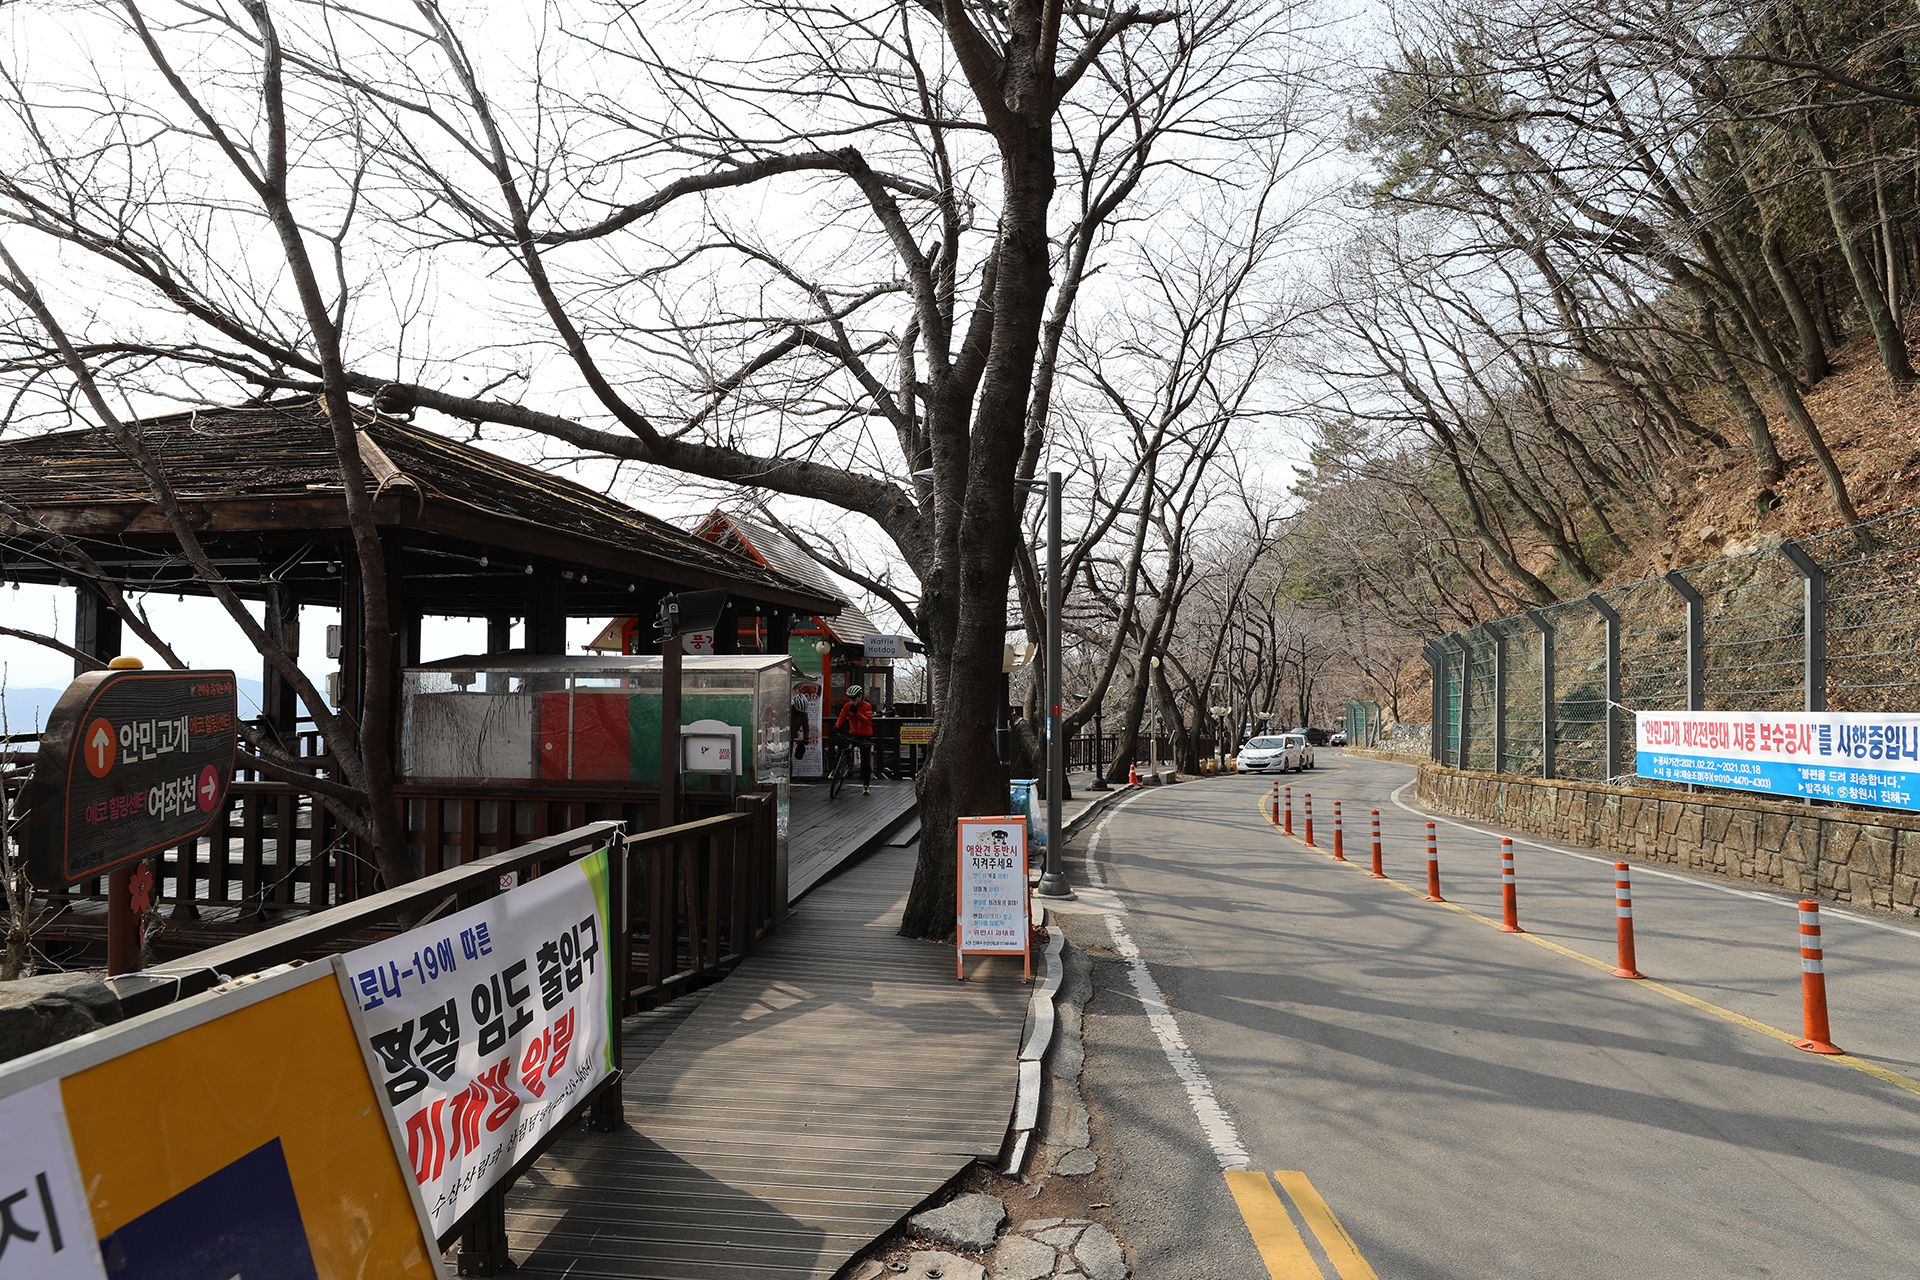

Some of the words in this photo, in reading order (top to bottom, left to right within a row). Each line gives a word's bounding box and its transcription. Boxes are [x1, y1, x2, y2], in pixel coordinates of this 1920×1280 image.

[868, 646, 896, 655] Hotdog
[870, 638, 894, 646] Waffle
[119, 715, 189, 765] 안민고개
[1683, 721, 1729, 750] 제2전망대
[1733, 722, 1756, 752] 지붕
[1658, 768, 1664, 777] 시
[1666, 768, 1672, 777] 공
[1829, 771, 1846, 783] 드려
[149, 774, 196, 822] 여좌천
[1805, 782, 1834, 796] 발주처:
[1849, 786, 1877, 801] 창원시
[1880, 790, 1911, 805] 진해구
[966, 845, 991, 857] 애완견
[993, 845, 1018, 857] 동반시
[972, 858, 1014, 870] 지켜주세요
[460, 921, 493, 960] 따른
[471, 958, 534, 1057] 임도
[536, 914, 599, 1012] 출입구
[405, 1056, 520, 1185] 미개방
[522, 1006, 575, 1099] 알림
[431, 1142, 503, 1219] 수산산림과
